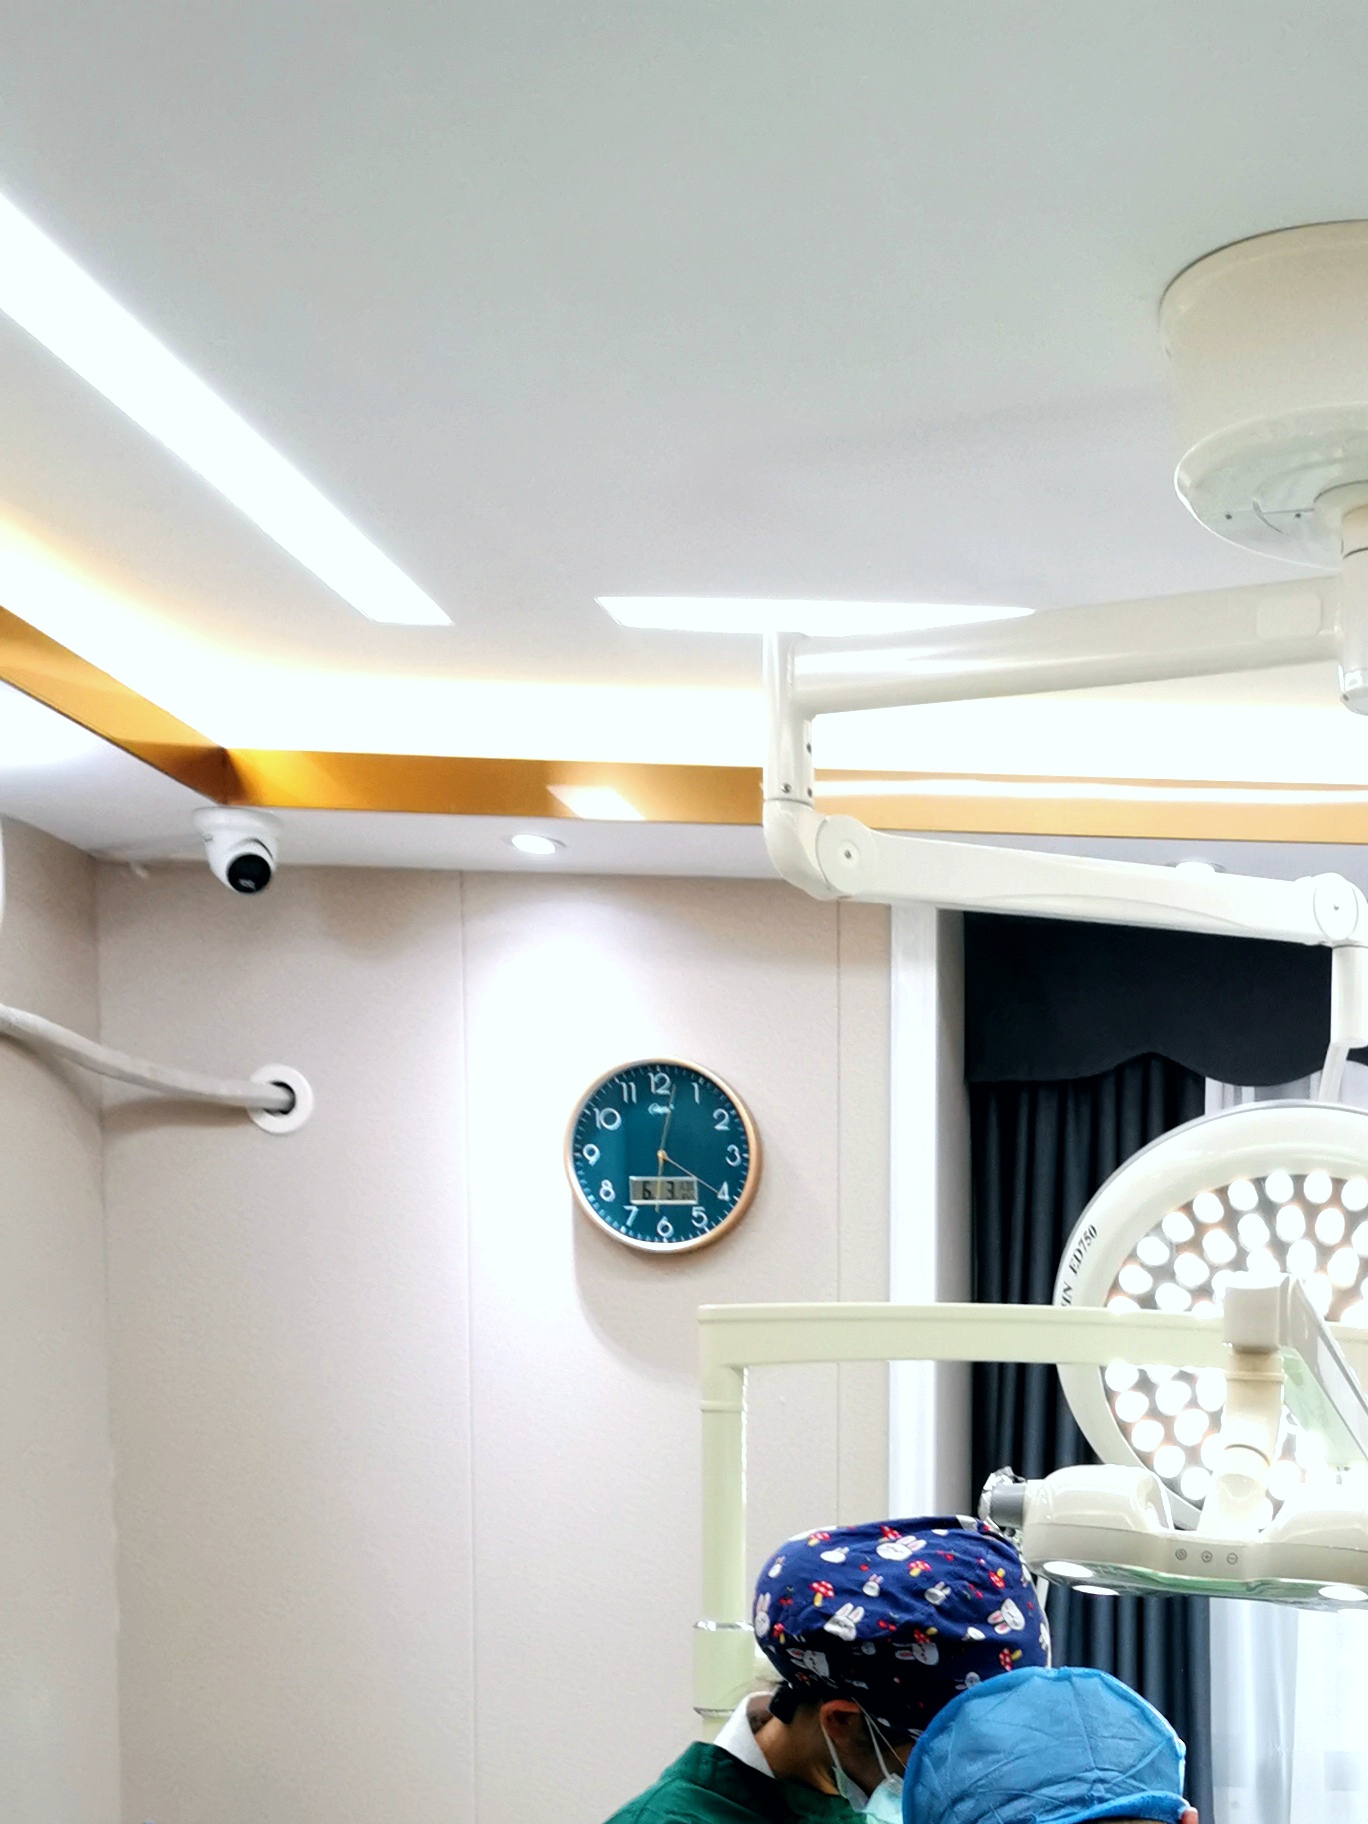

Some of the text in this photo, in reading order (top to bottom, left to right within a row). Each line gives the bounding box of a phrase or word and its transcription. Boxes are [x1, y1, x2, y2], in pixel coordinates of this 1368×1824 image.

[621, 1081, 637, 1104] 11
[648, 1072, 671, 1095] 12
[692, 1082, 701, 1104] 1
[594, 1107, 622, 1131] 10
[713, 1108, 730, 1131] 2
[582, 1144, 601, 1166] 9
[725, 1145, 741, 1167] 3
[599, 1180, 616, 1203] 8
[717, 1182, 730, 1201] 4
[623, 1206, 639, 1227] 7
[657, 1216, 675, 1238] 6
[692, 1206, 708, 1228] 5
